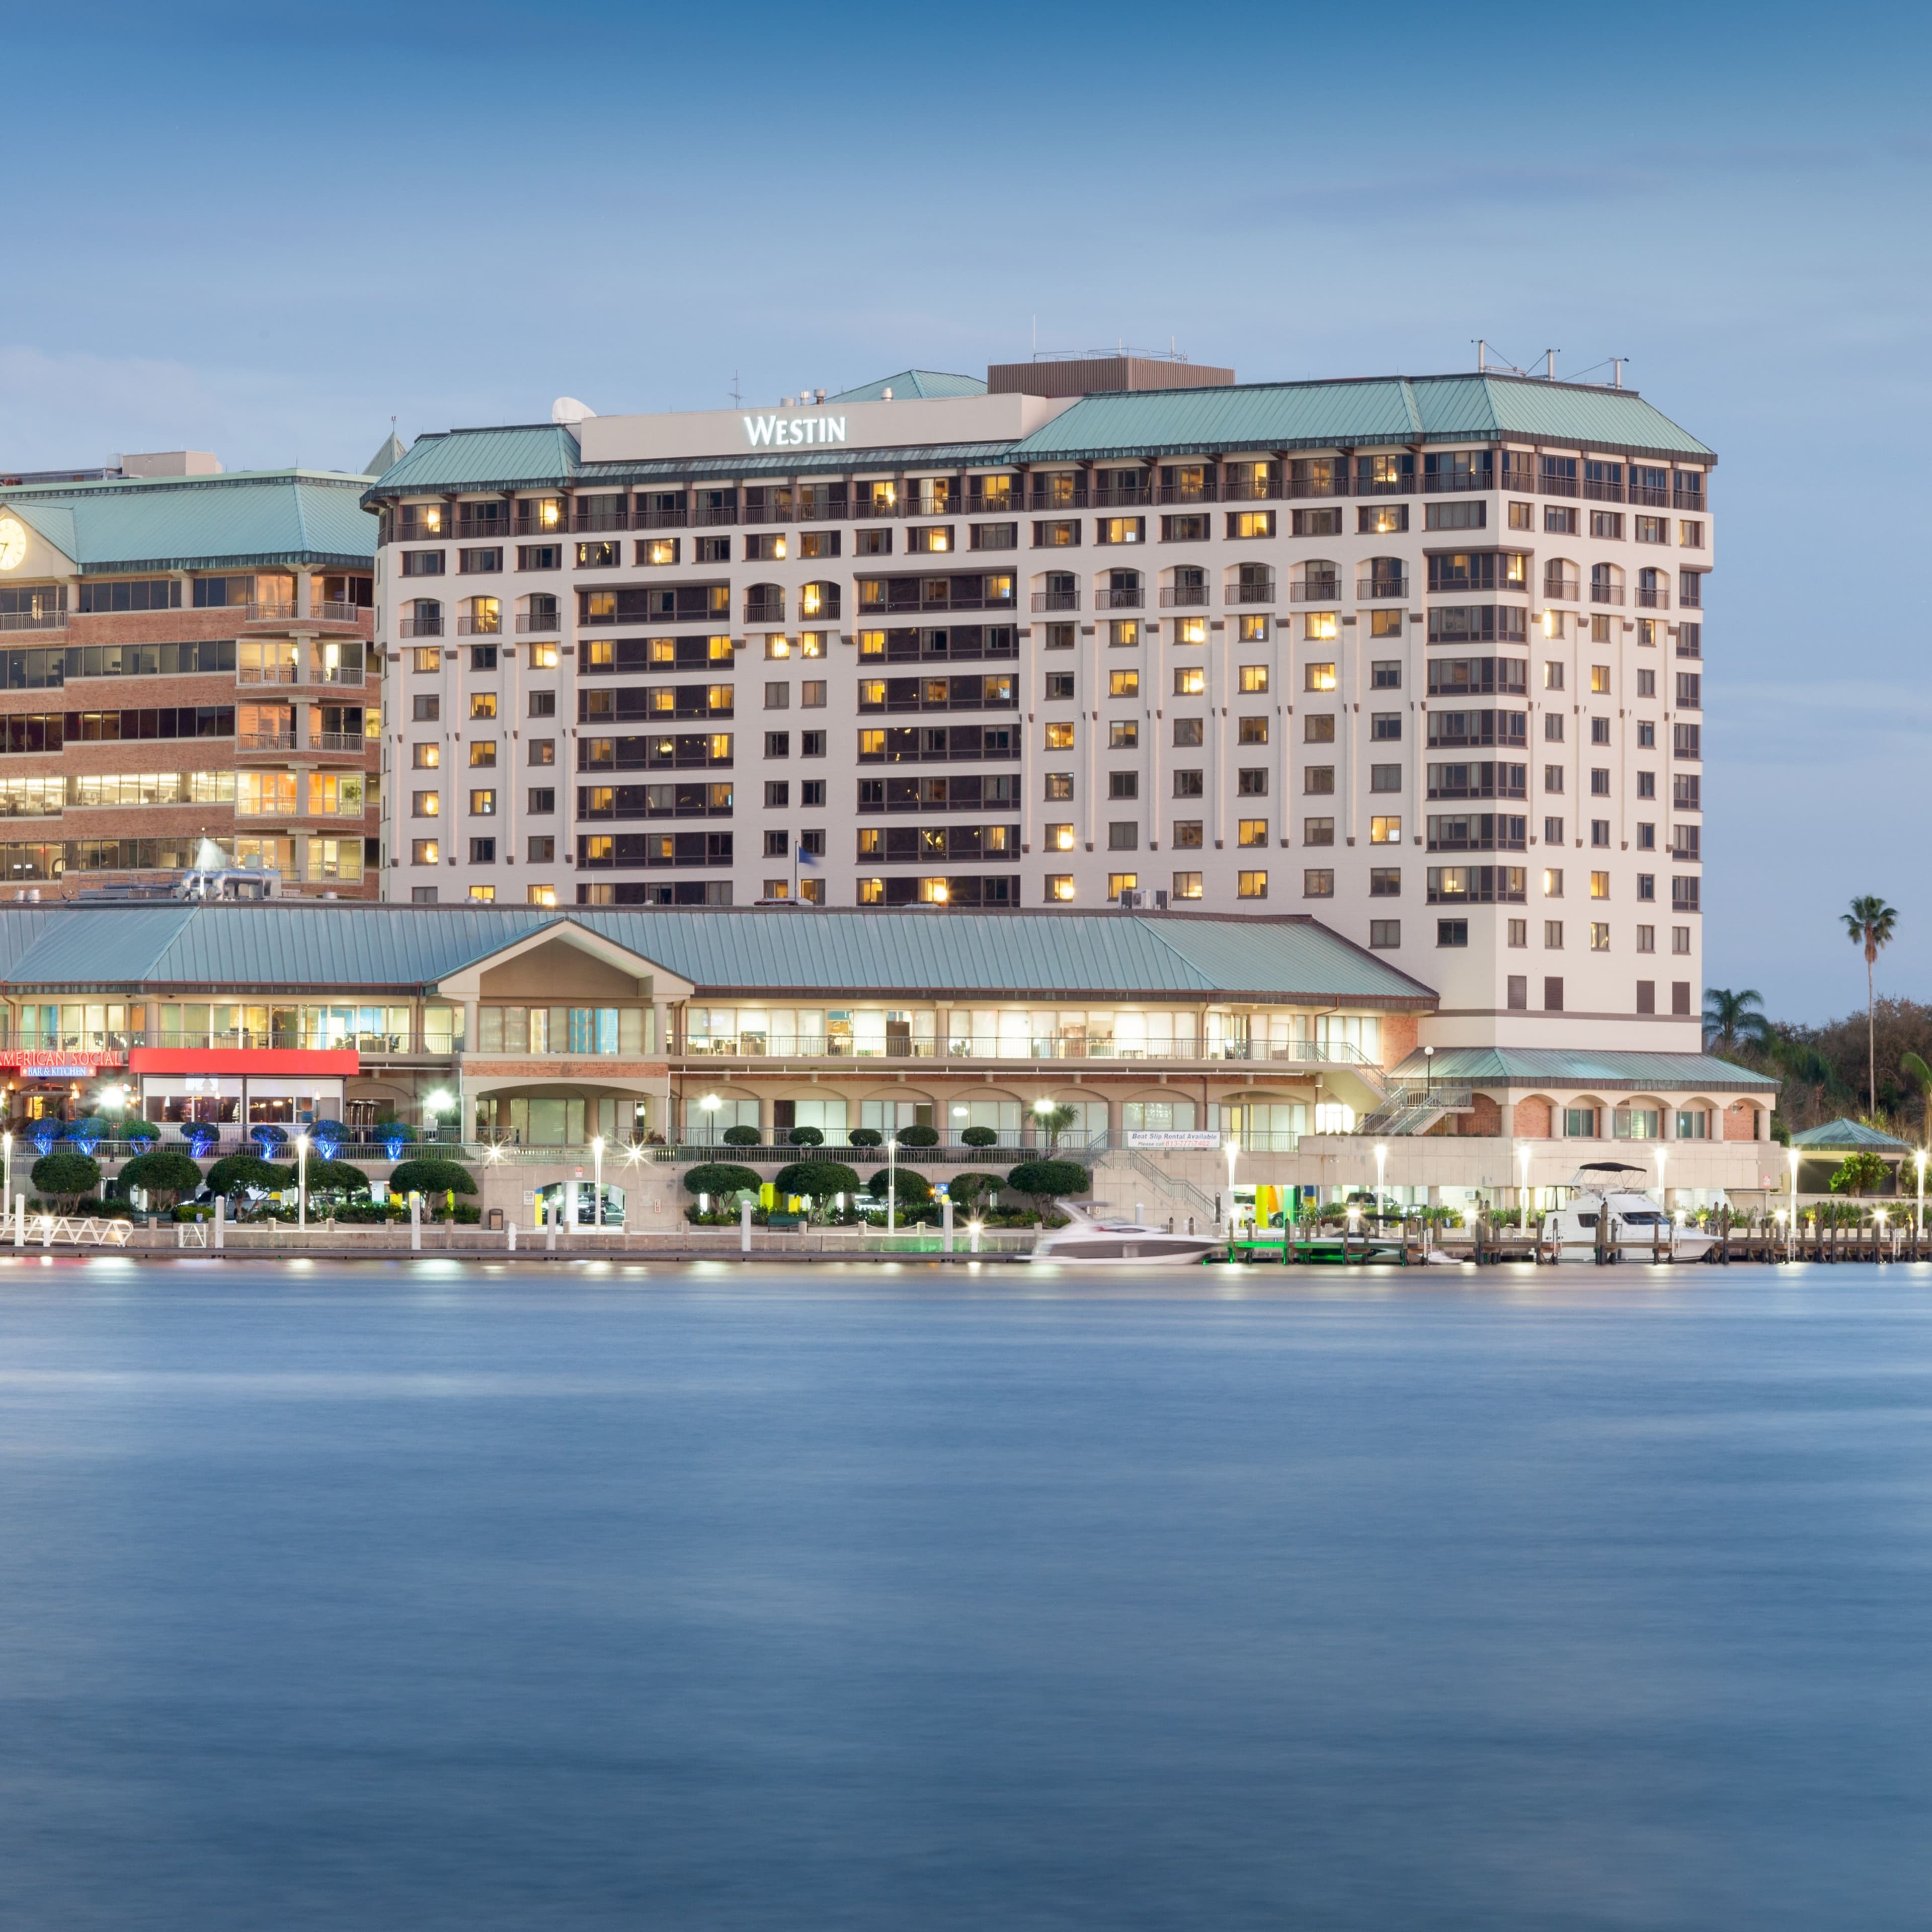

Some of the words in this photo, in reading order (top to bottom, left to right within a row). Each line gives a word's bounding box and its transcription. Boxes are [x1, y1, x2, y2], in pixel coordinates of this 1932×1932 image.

[743, 415, 846, 447] WESTIN
[0, 1051, 65, 1066] MERICAN
[71, 1051, 121, 1066] SOCIAL
[28, 1067, 44, 1076] BAR
[44, 1068, 50, 1076] &
[52, 1067, 86, 1076] KITCHEN
